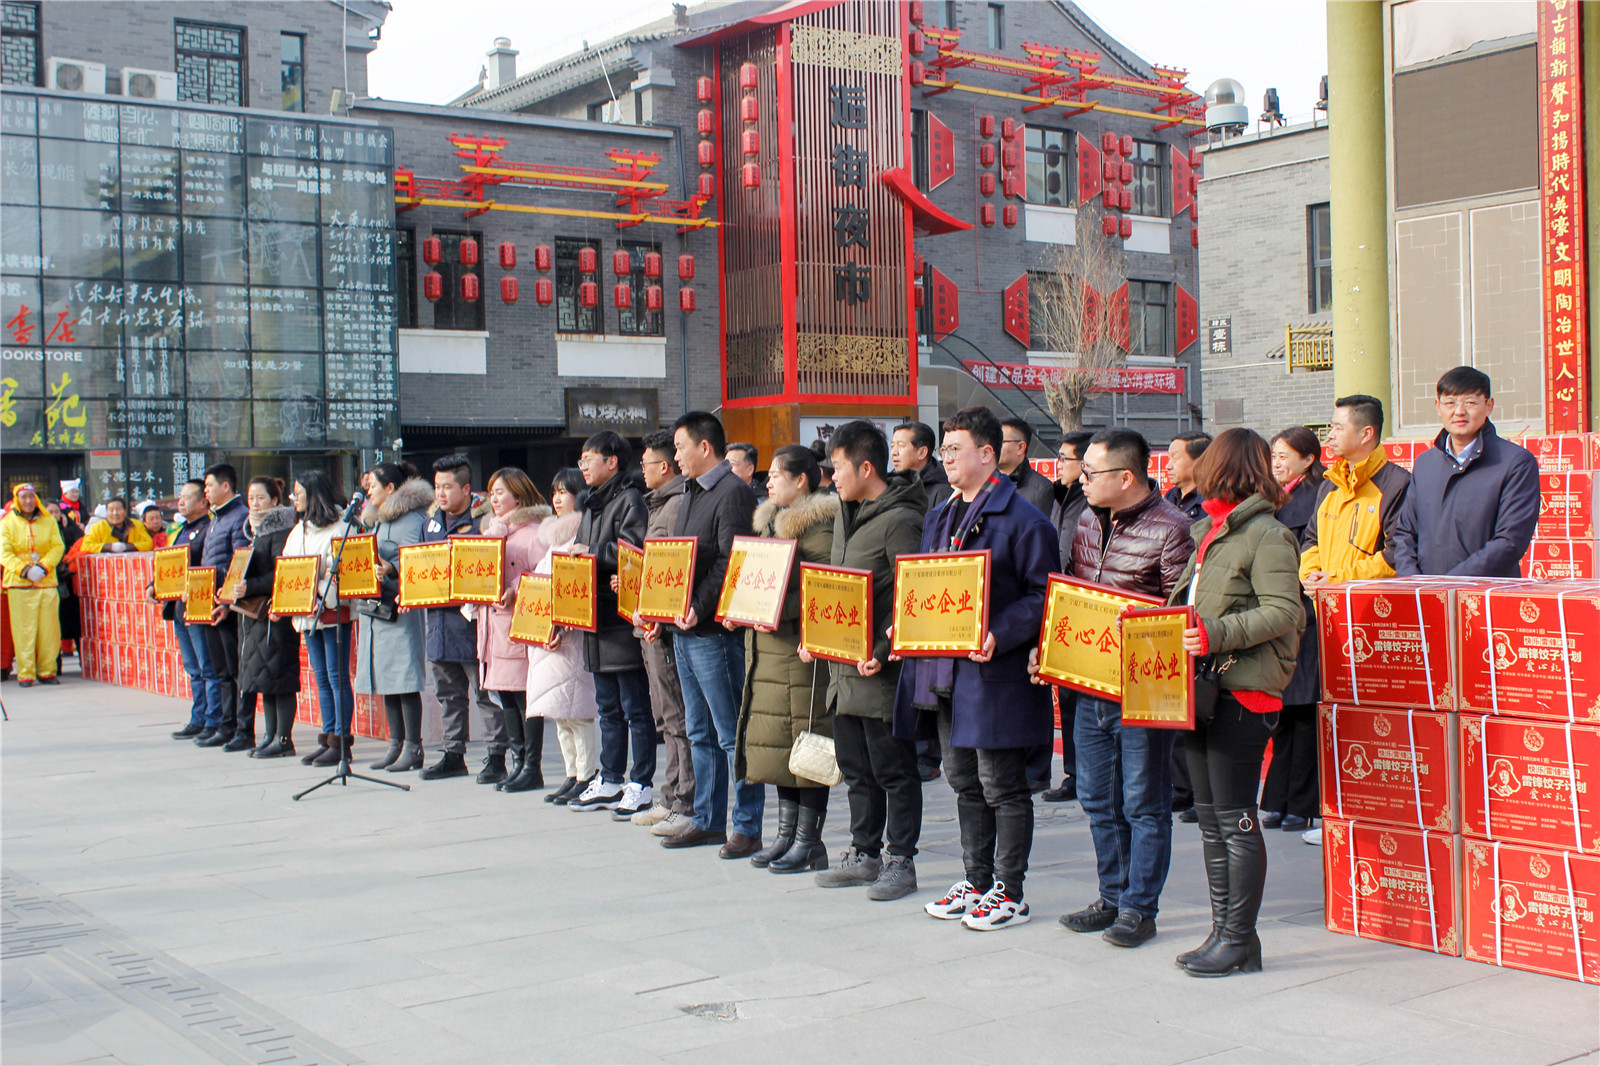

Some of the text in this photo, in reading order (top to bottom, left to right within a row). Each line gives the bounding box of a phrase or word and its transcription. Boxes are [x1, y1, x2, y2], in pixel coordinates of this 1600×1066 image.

[0, 350, 83, 362] OOKSTORE
[455, 559, 496, 578] 爱心企业
[645, 566, 684, 589] 爱心企业
[730, 566, 777, 591] 爱心企业
[278, 575, 310, 594] 爱心企业
[555, 577, 588, 599] 爱心企业
[808, 597, 861, 627] 爱心企业
[904, 587, 973, 618] 爱心企业
[1055, 615, 1121, 659] 爱心企
[1127, 650, 1181, 684] 爱心企业
